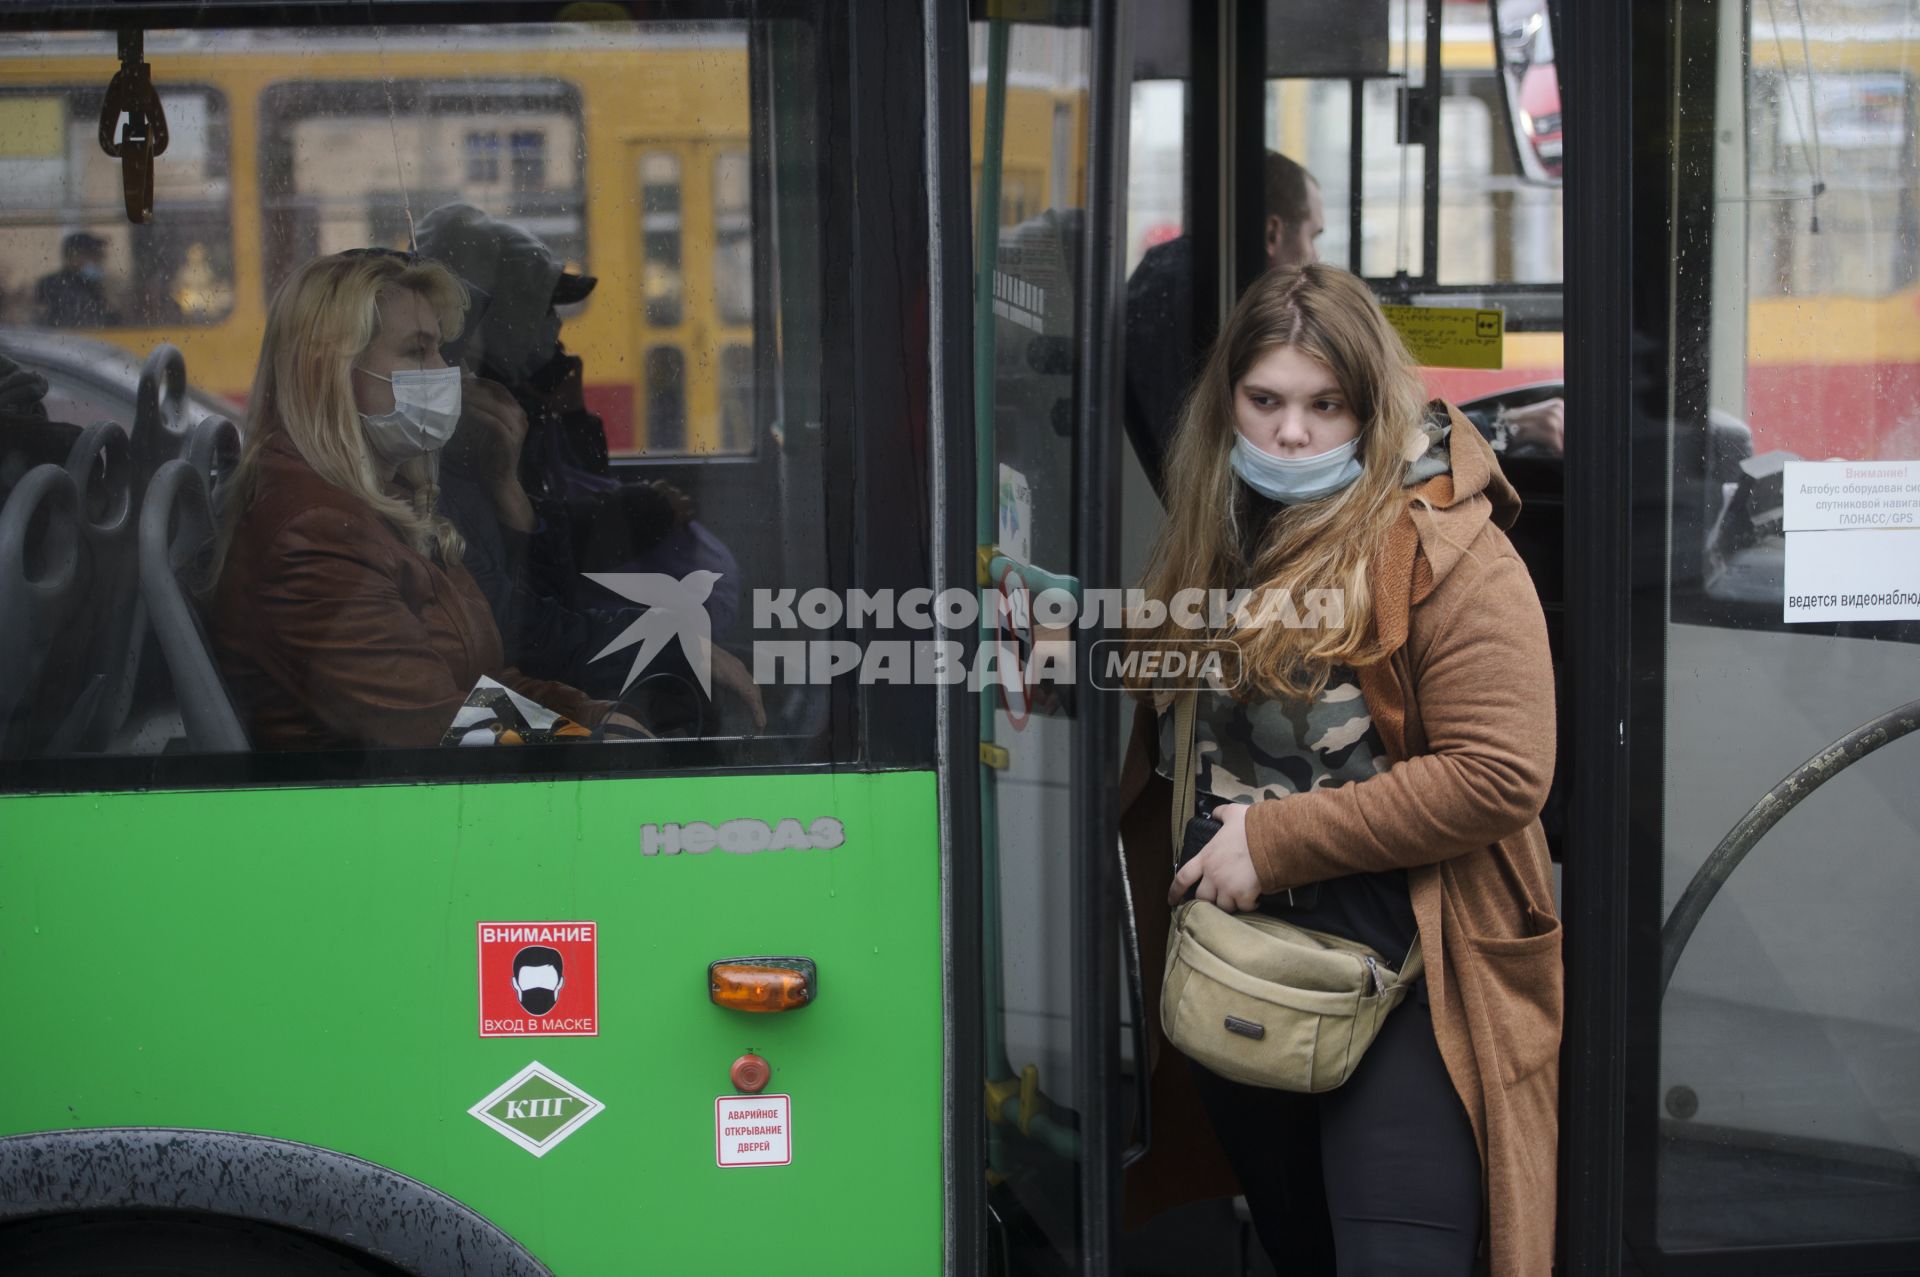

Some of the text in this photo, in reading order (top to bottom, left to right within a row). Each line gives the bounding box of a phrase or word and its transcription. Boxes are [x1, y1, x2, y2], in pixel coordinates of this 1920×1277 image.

[1845, 467, 1908, 479] Внимание!
[1800, 484, 1840, 496] Автобус
[1842, 483, 1903, 495] оборудован
[1815, 499, 1880, 511] спутниковой
[1838, 513, 1913, 525] ГЛОНАСС/GPS
[1788, 594, 1838, 610] ведется
[483, 927, 592, 943] ВНИМАНИЕ
[485, 1019, 592, 1032] ВХОД В МАСКЕ
[505, 1097, 573, 1119] КПГ
[728, 1108, 779, 1120] АВАРИЙНОЕ
[724, 1125, 782, 1137] ОТКРЫВАНИЕ
[737, 1140, 770, 1154] ДВЕРЕЙ
